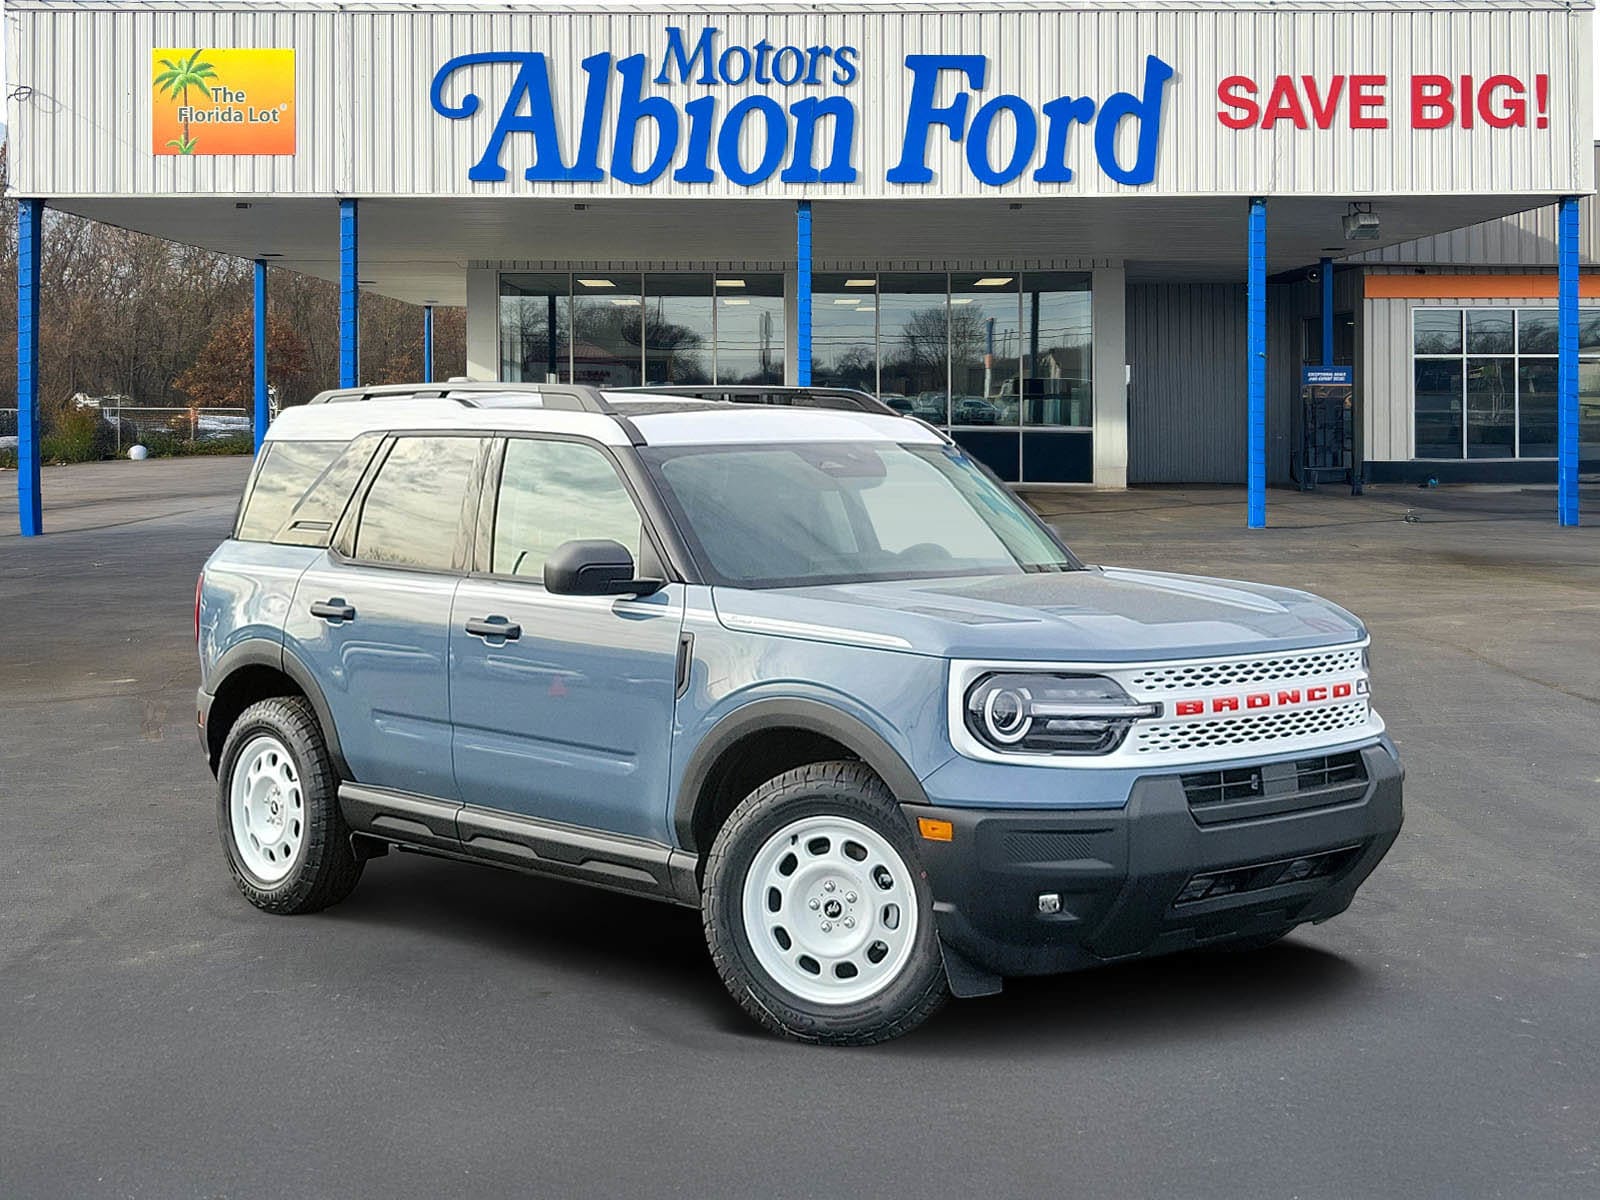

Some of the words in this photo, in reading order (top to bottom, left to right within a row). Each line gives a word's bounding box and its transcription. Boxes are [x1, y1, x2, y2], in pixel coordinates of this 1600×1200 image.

[654, 27, 857, 86] Motors
[178, 106, 244, 122] Florida
[211, 86, 246, 103] The
[1217, 75, 1388, 129] SAVE
[1411, 74, 1549, 129] BIG!
[430, 51, 858, 186] Albion
[887, 54, 1174, 186] Ford
[1176, 683, 1351, 716] BRONCO
